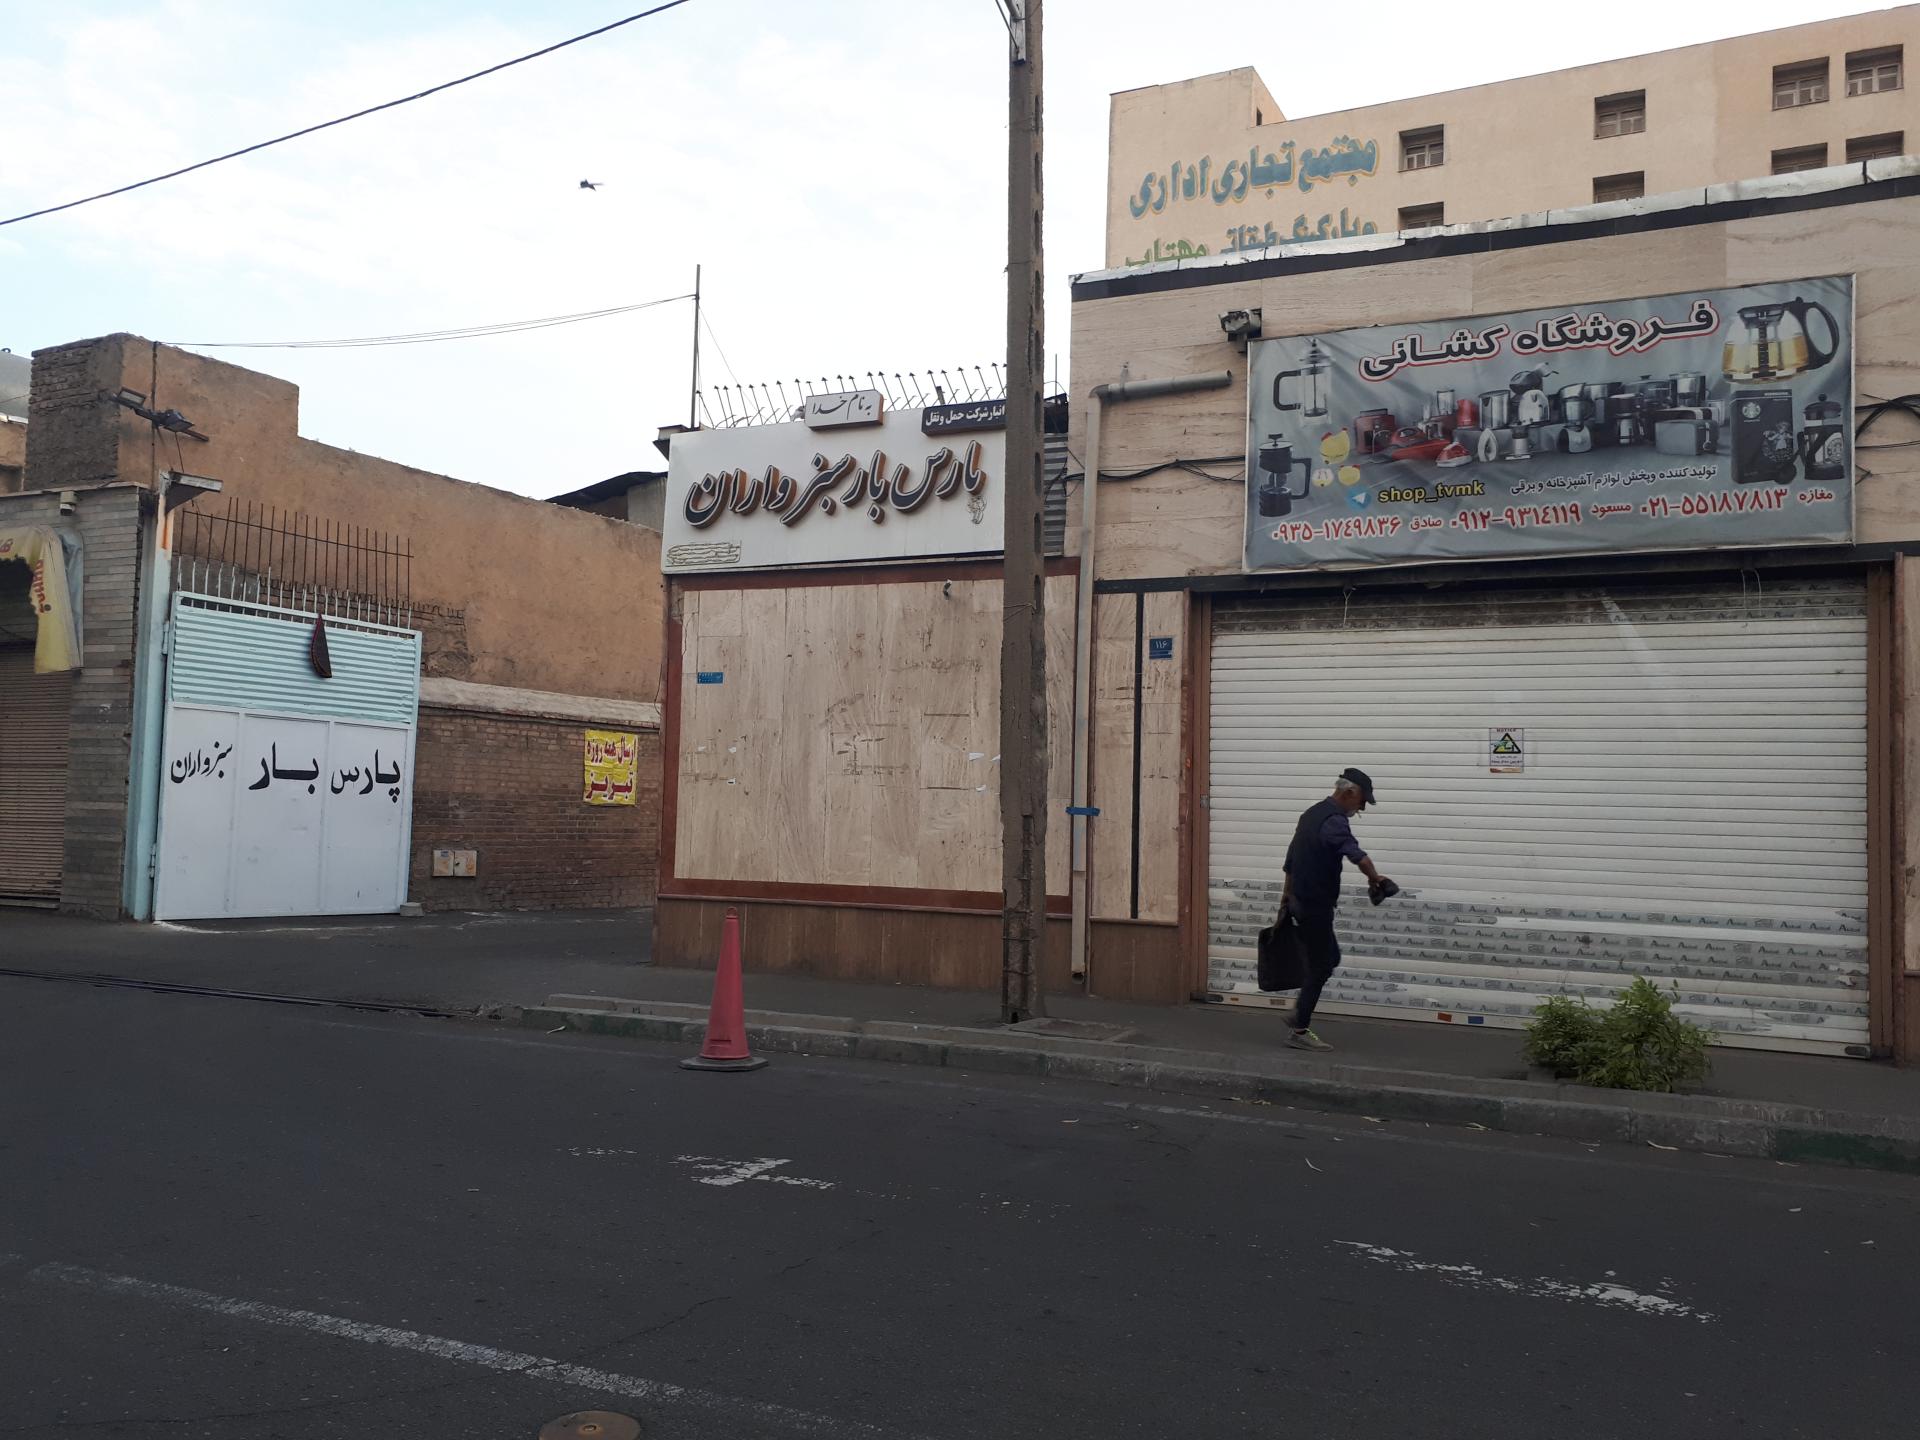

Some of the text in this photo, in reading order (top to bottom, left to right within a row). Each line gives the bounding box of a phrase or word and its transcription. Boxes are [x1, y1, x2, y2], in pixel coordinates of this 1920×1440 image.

[1129, 134, 1377, 219] مجتمع تجاری اداری
[1361, 300, 1718, 380] فروشگاه کشانی
[812, 396, 847, 414] خدا
[846, 394, 865, 420] نام
[946, 410, 963, 424] حمل
[683, 453, 856, 527] سبزواران
[841, 450, 886, 523] بار
[1511, 480, 1535, 494] برقی
[1546, 473, 1593, 490] آشپزخانه
[1594, 474, 1620, 490] لوازم
[1378, 480, 1485, 503] shop_tvmk
[1798, 488, 1833, 502] مغازه
[1591, 503, 1632, 517] مسعود
[1410, 517, 1442, 531] صادق
[171, 741, 401, 803] پارس بار سبزواران
